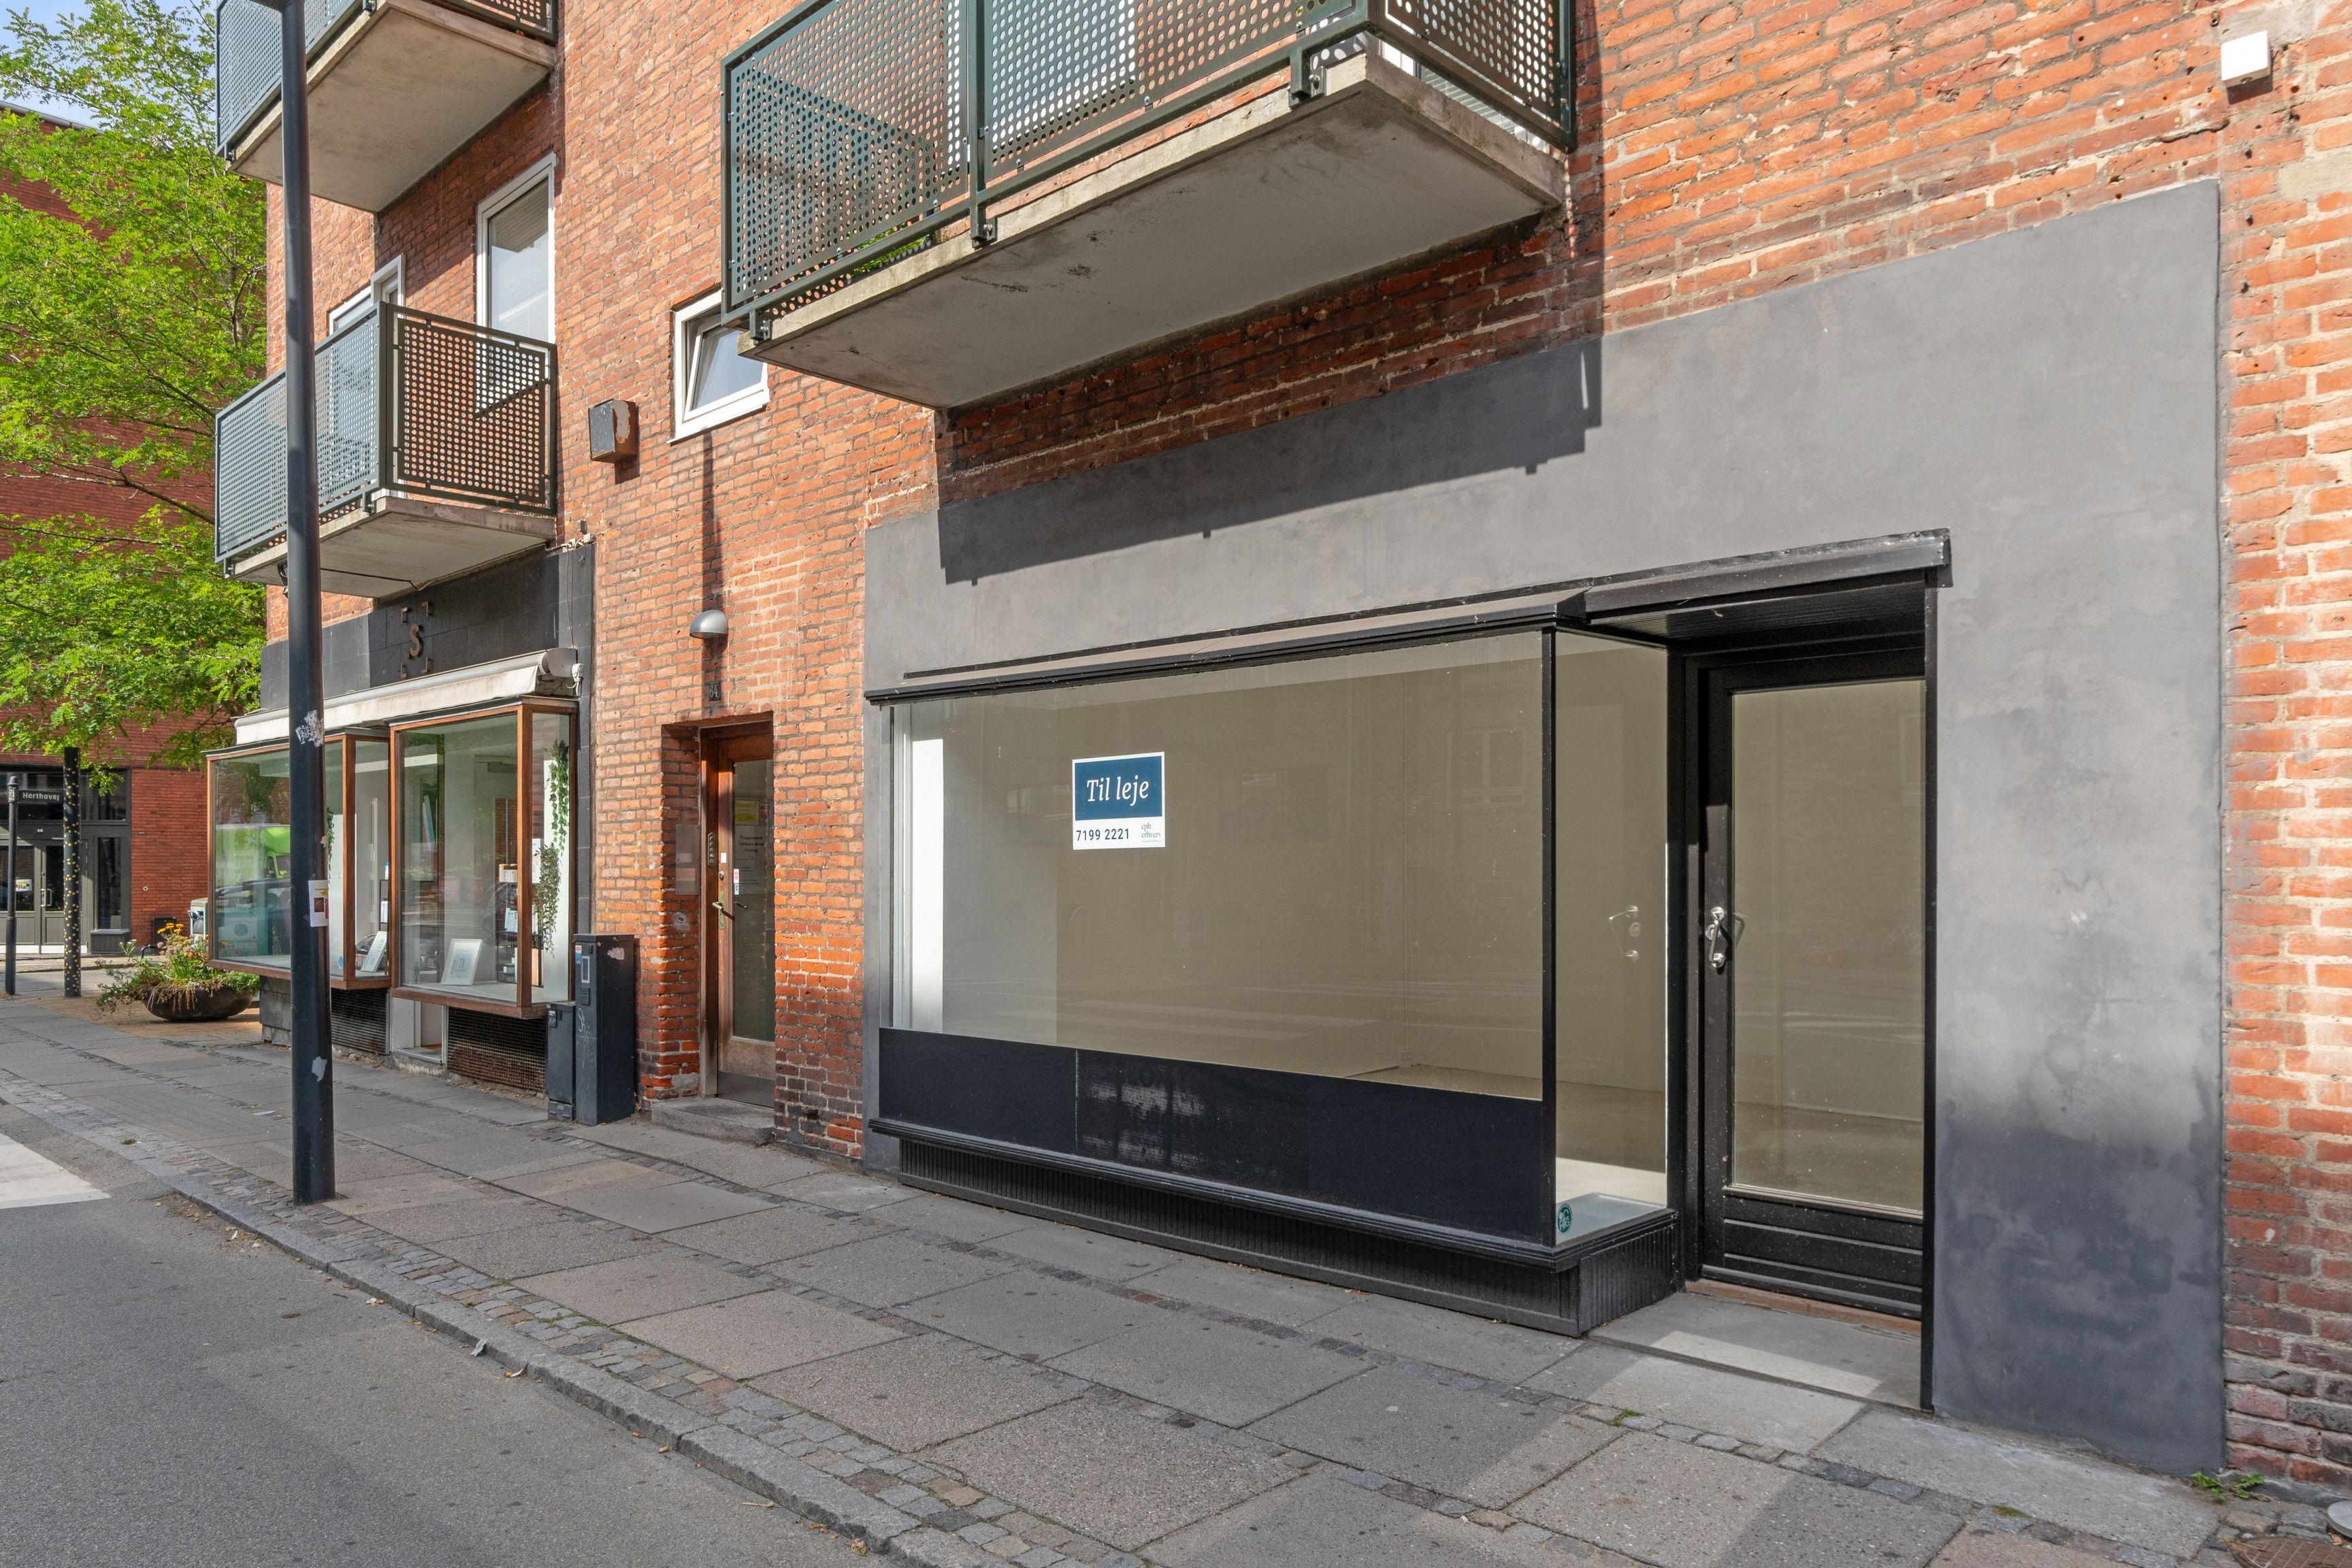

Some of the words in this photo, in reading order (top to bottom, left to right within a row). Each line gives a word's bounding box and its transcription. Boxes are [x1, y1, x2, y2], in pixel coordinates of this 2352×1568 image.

[1086, 777, 1110, 802] Til
[1116, 774, 1149, 806] leje
[22, 792, 59, 801] Herthavej
[1141, 822, 1152, 832] cph
[1076, 829, 1100, 841] 7199
[1105, 828, 1129, 840] 2221
